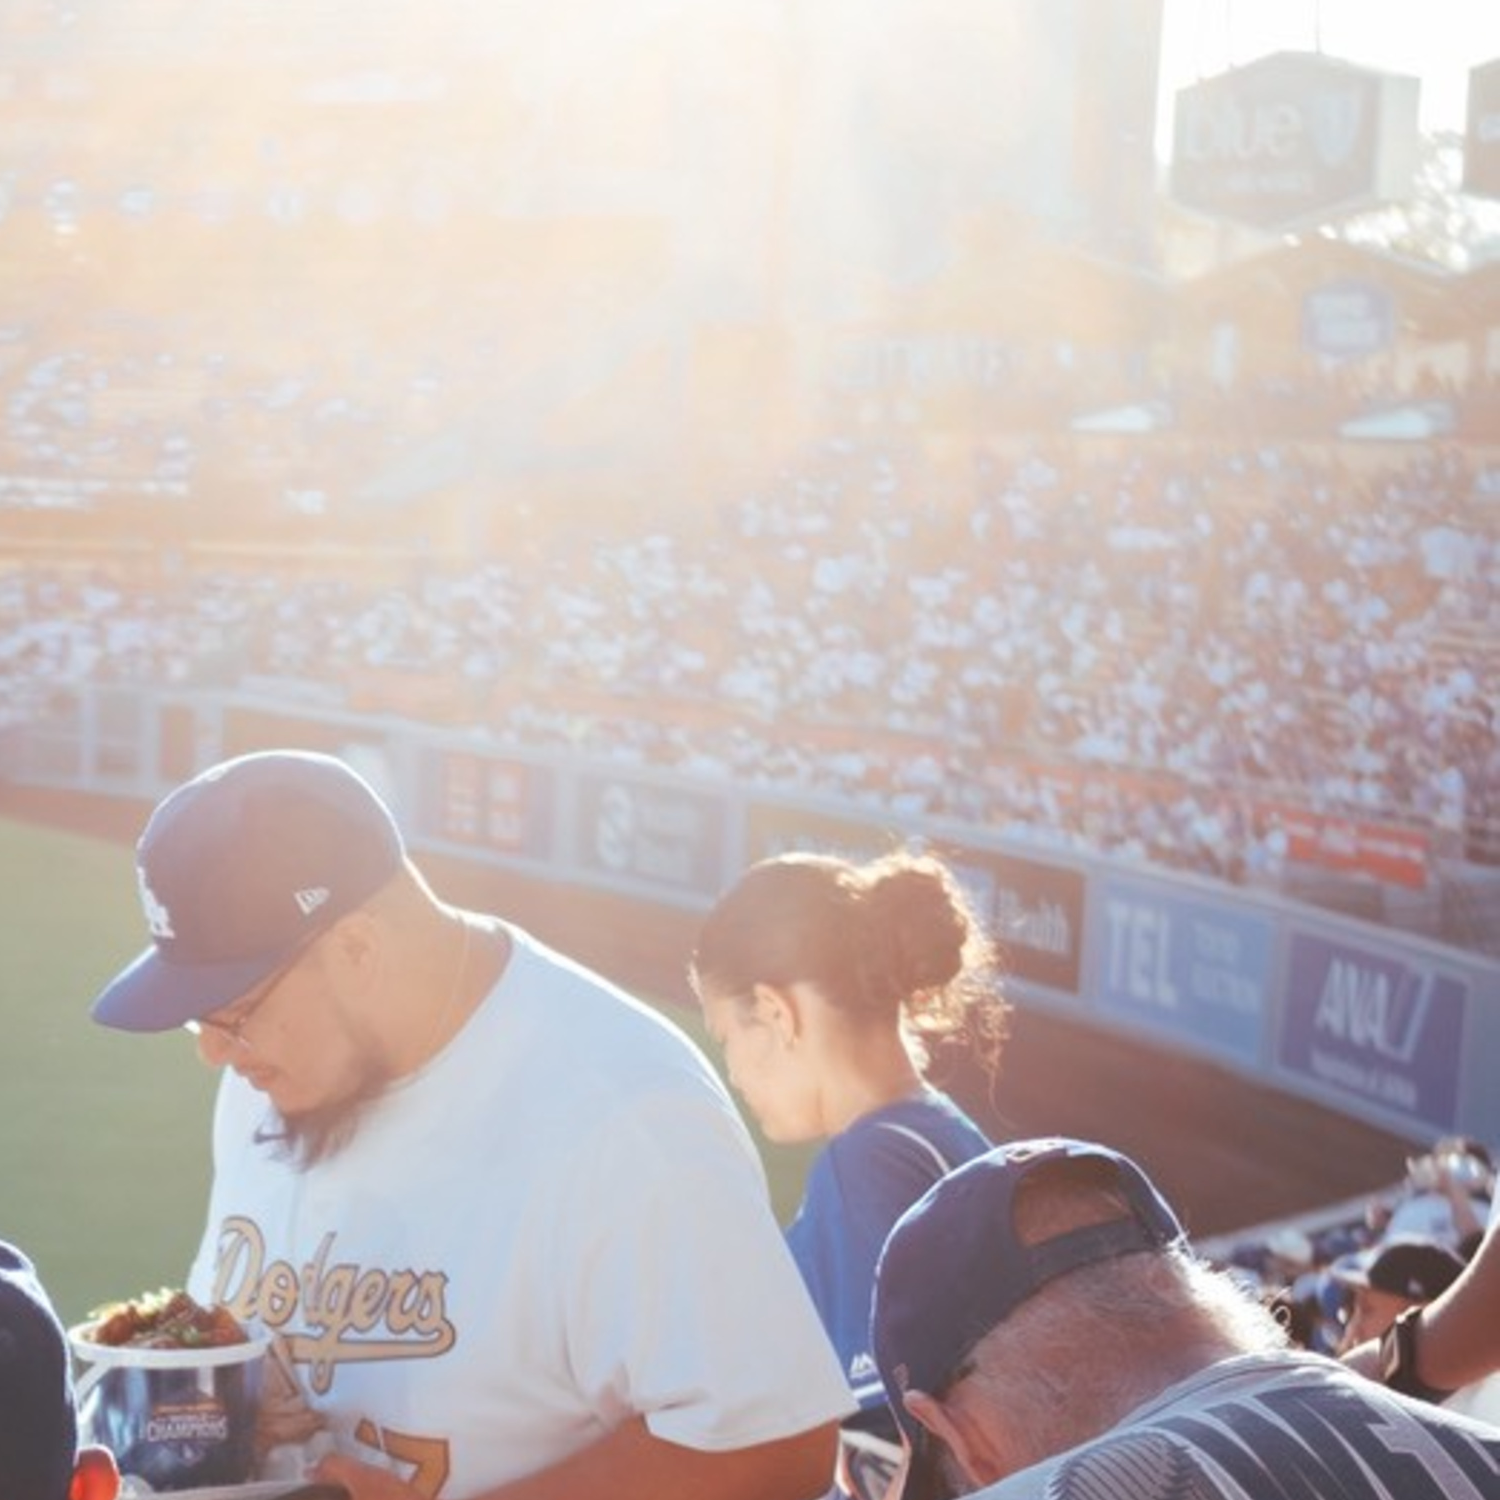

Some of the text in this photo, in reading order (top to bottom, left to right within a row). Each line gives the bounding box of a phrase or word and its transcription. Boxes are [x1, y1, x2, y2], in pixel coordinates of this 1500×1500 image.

[1107, 897, 1180, 1010] TEL
[1314, 957, 1392, 1054] ANA
[212, 1215, 456, 1396] Dodgers
